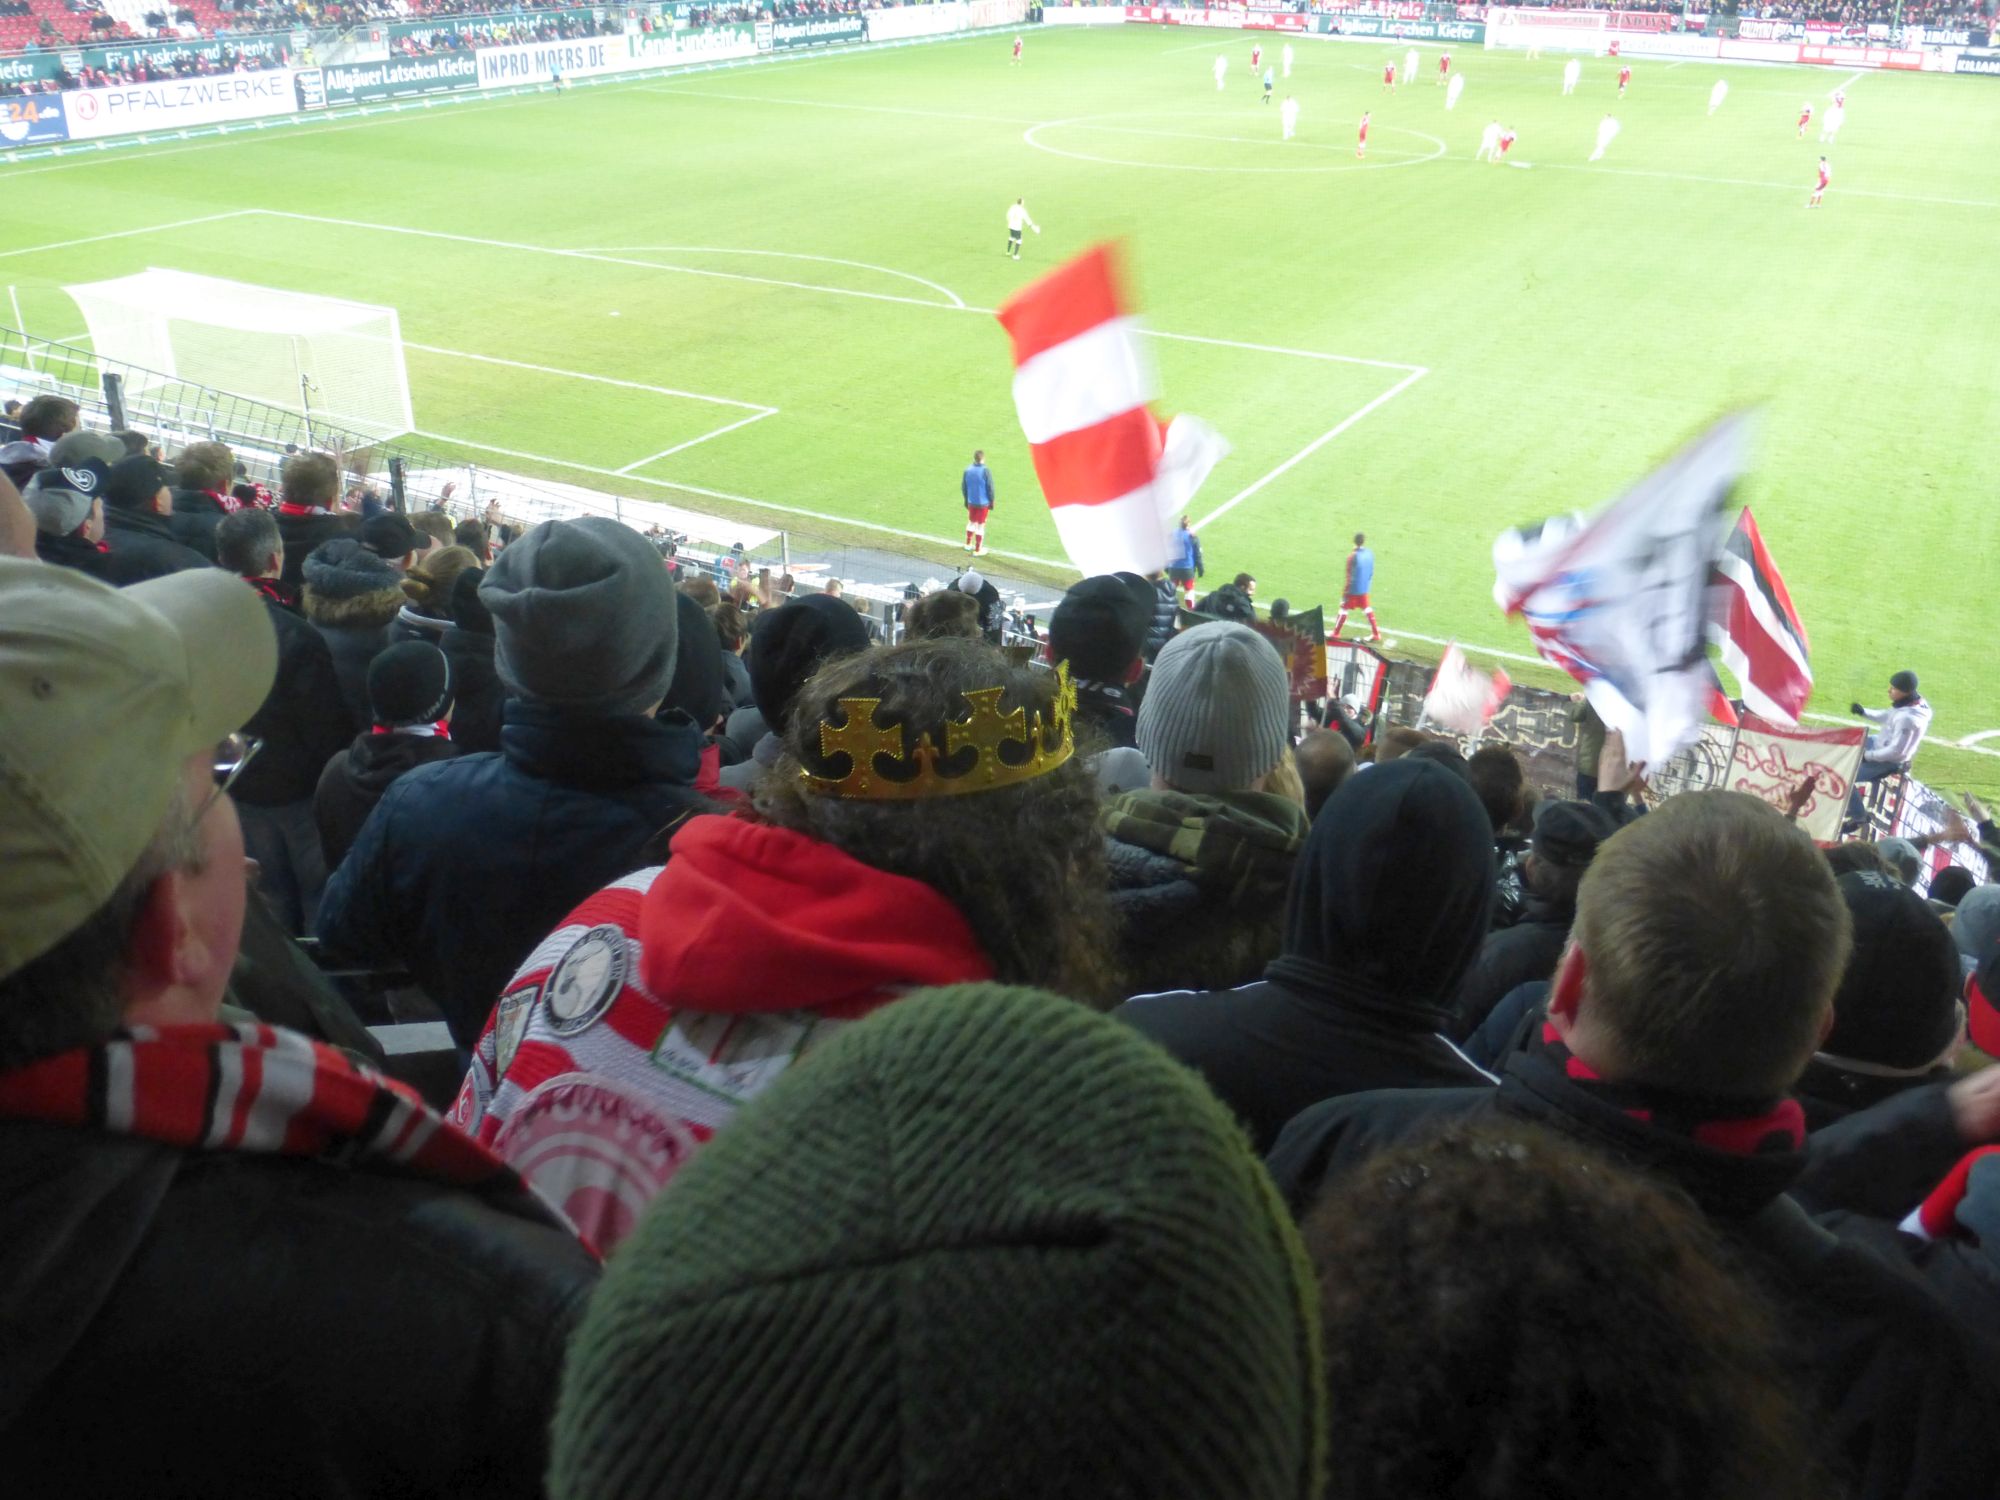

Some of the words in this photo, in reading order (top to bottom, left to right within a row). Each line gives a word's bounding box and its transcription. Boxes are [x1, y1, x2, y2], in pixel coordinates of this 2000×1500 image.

[1438, 23, 1475, 39] Kiefer
[195, 43, 220, 61] nd
[0, 60, 33, 80] iefer
[326, 67, 382, 94] Allgäuer
[382, 61, 438, 84] Latschen
[438, 56, 476, 77] Kiefer
[482, 51, 529, 80] INPRO
[107, 76, 285, 114] PFALZWERKE
